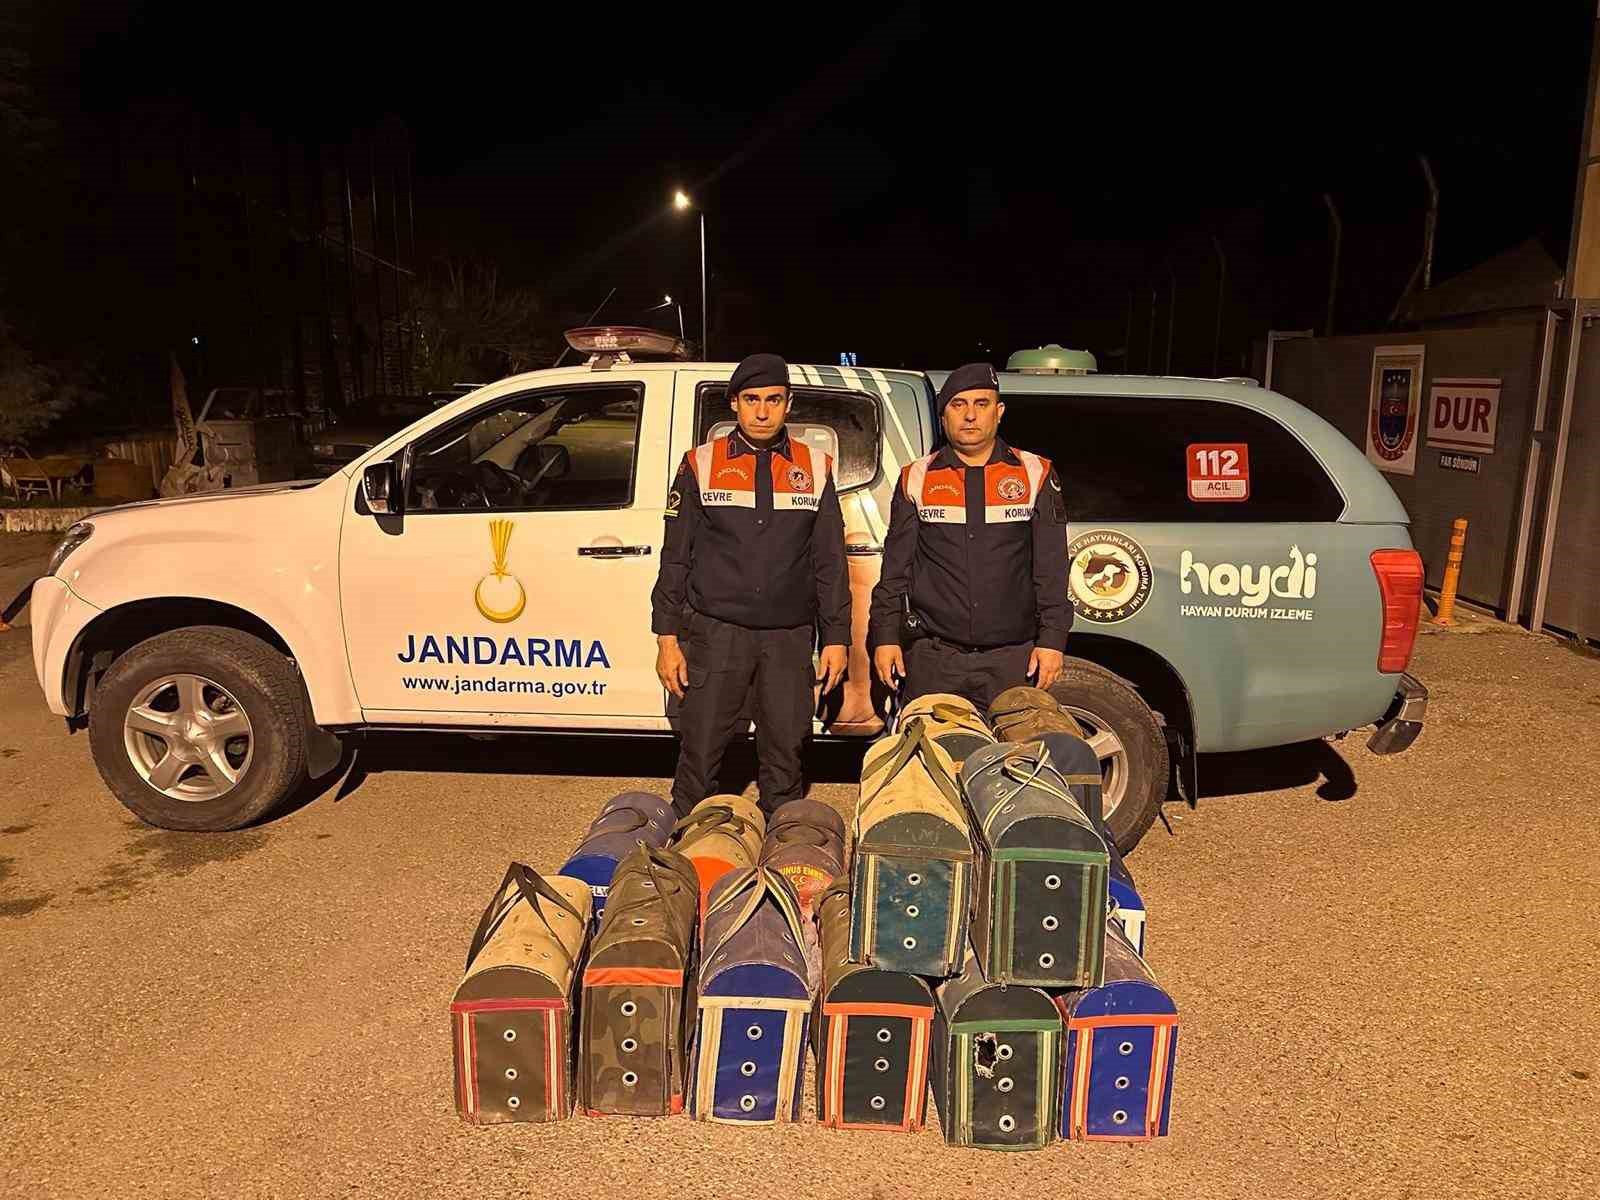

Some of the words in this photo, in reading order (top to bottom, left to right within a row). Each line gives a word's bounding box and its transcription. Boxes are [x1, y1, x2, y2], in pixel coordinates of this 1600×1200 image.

[1434, 396, 1492, 433] DUR
[1196, 449, 1240, 476] 112
[1072, 542, 1083, 553] VE
[1084, 534, 1137, 554] HAYVANLARI
[1134, 554, 1149, 590] KORUMA
[1181, 544, 1317, 607] haydi
[1181, 605, 1221, 617] HAYVAN
[1224, 607, 1267, 619] DURUM
[398, 634, 611, 669] JANDARMA
[402, 675, 607, 697] www.jandarma.gov.tr
